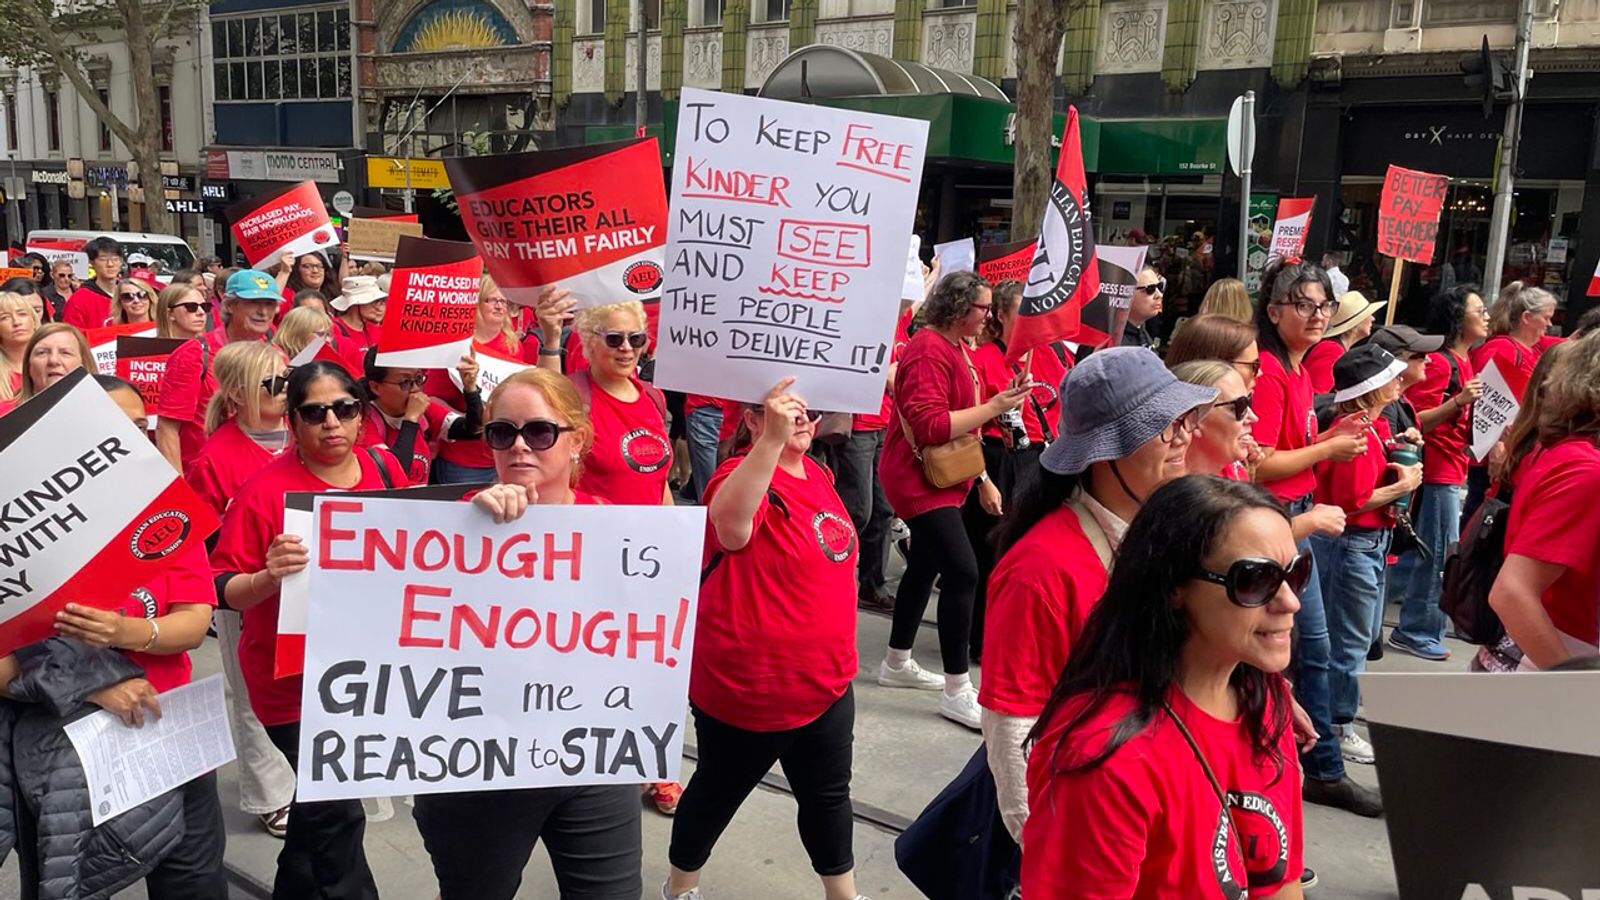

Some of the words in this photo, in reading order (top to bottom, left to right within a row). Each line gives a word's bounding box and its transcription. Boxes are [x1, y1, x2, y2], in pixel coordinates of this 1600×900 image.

[686, 103, 730, 144] TO
[755, 114, 832, 155] KEEP
[841, 122, 914, 171] FREE
[685, 155, 793, 208] KINDER
[815, 182, 871, 216] YOU
[1391, 172, 1448, 199] BETTER
[239, 208, 283, 230] INCREASED
[469, 190, 595, 217] EDUCATORS
[1391, 194, 1424, 217] PAY
[242, 226, 259, 238] FAIR
[476, 220, 518, 239] GIVE
[521, 214, 588, 238] THEIR
[594, 208, 636, 229] ALL
[679, 208, 765, 245] MUST
[789, 225, 860, 261] SEE
[482, 242, 512, 260] PAY
[514, 236, 578, 260] THEM
[583, 225, 656, 253] FAIRLY
[1384, 236, 1426, 258] STAY
[408, 272, 471, 290] INCREASED
[630, 270, 657, 284] AEU
[671, 248, 744, 282] AND
[770, 262, 851, 293] KEEP
[1029, 227, 1084, 314] EDUCATION
[402, 303, 436, 319] REAL
[405, 287, 436, 303] FAIR
[666, 287, 717, 316] THE
[738, 295, 843, 333] PEOPLE
[400, 318, 449, 334] KINDER
[669, 325, 719, 348] WHO
[729, 328, 834, 364] DELIVER
[850, 342, 888, 374] IT!
[129, 371, 158, 383] FAIR
[1480, 403, 1507, 428] KINDER
[1488, 391, 1516, 413] PARITY
[0, 436, 131, 534] KINDER
[0, 502, 88, 569] WITH
[144, 519, 180, 552] AEU
[318, 501, 583, 582] ENOUGH
[620, 538, 661, 579] is
[398, 583, 690, 669] ENOUGH!
[317, 660, 485, 720] GIVE
[522, 681, 583, 713] me
[603, 684, 634, 711] a
[311, 729, 519, 784] REASON
[528, 738, 559, 769] to
[559, 722, 679, 781] STAY
[1242, 796, 1288, 860] EDUCATION
